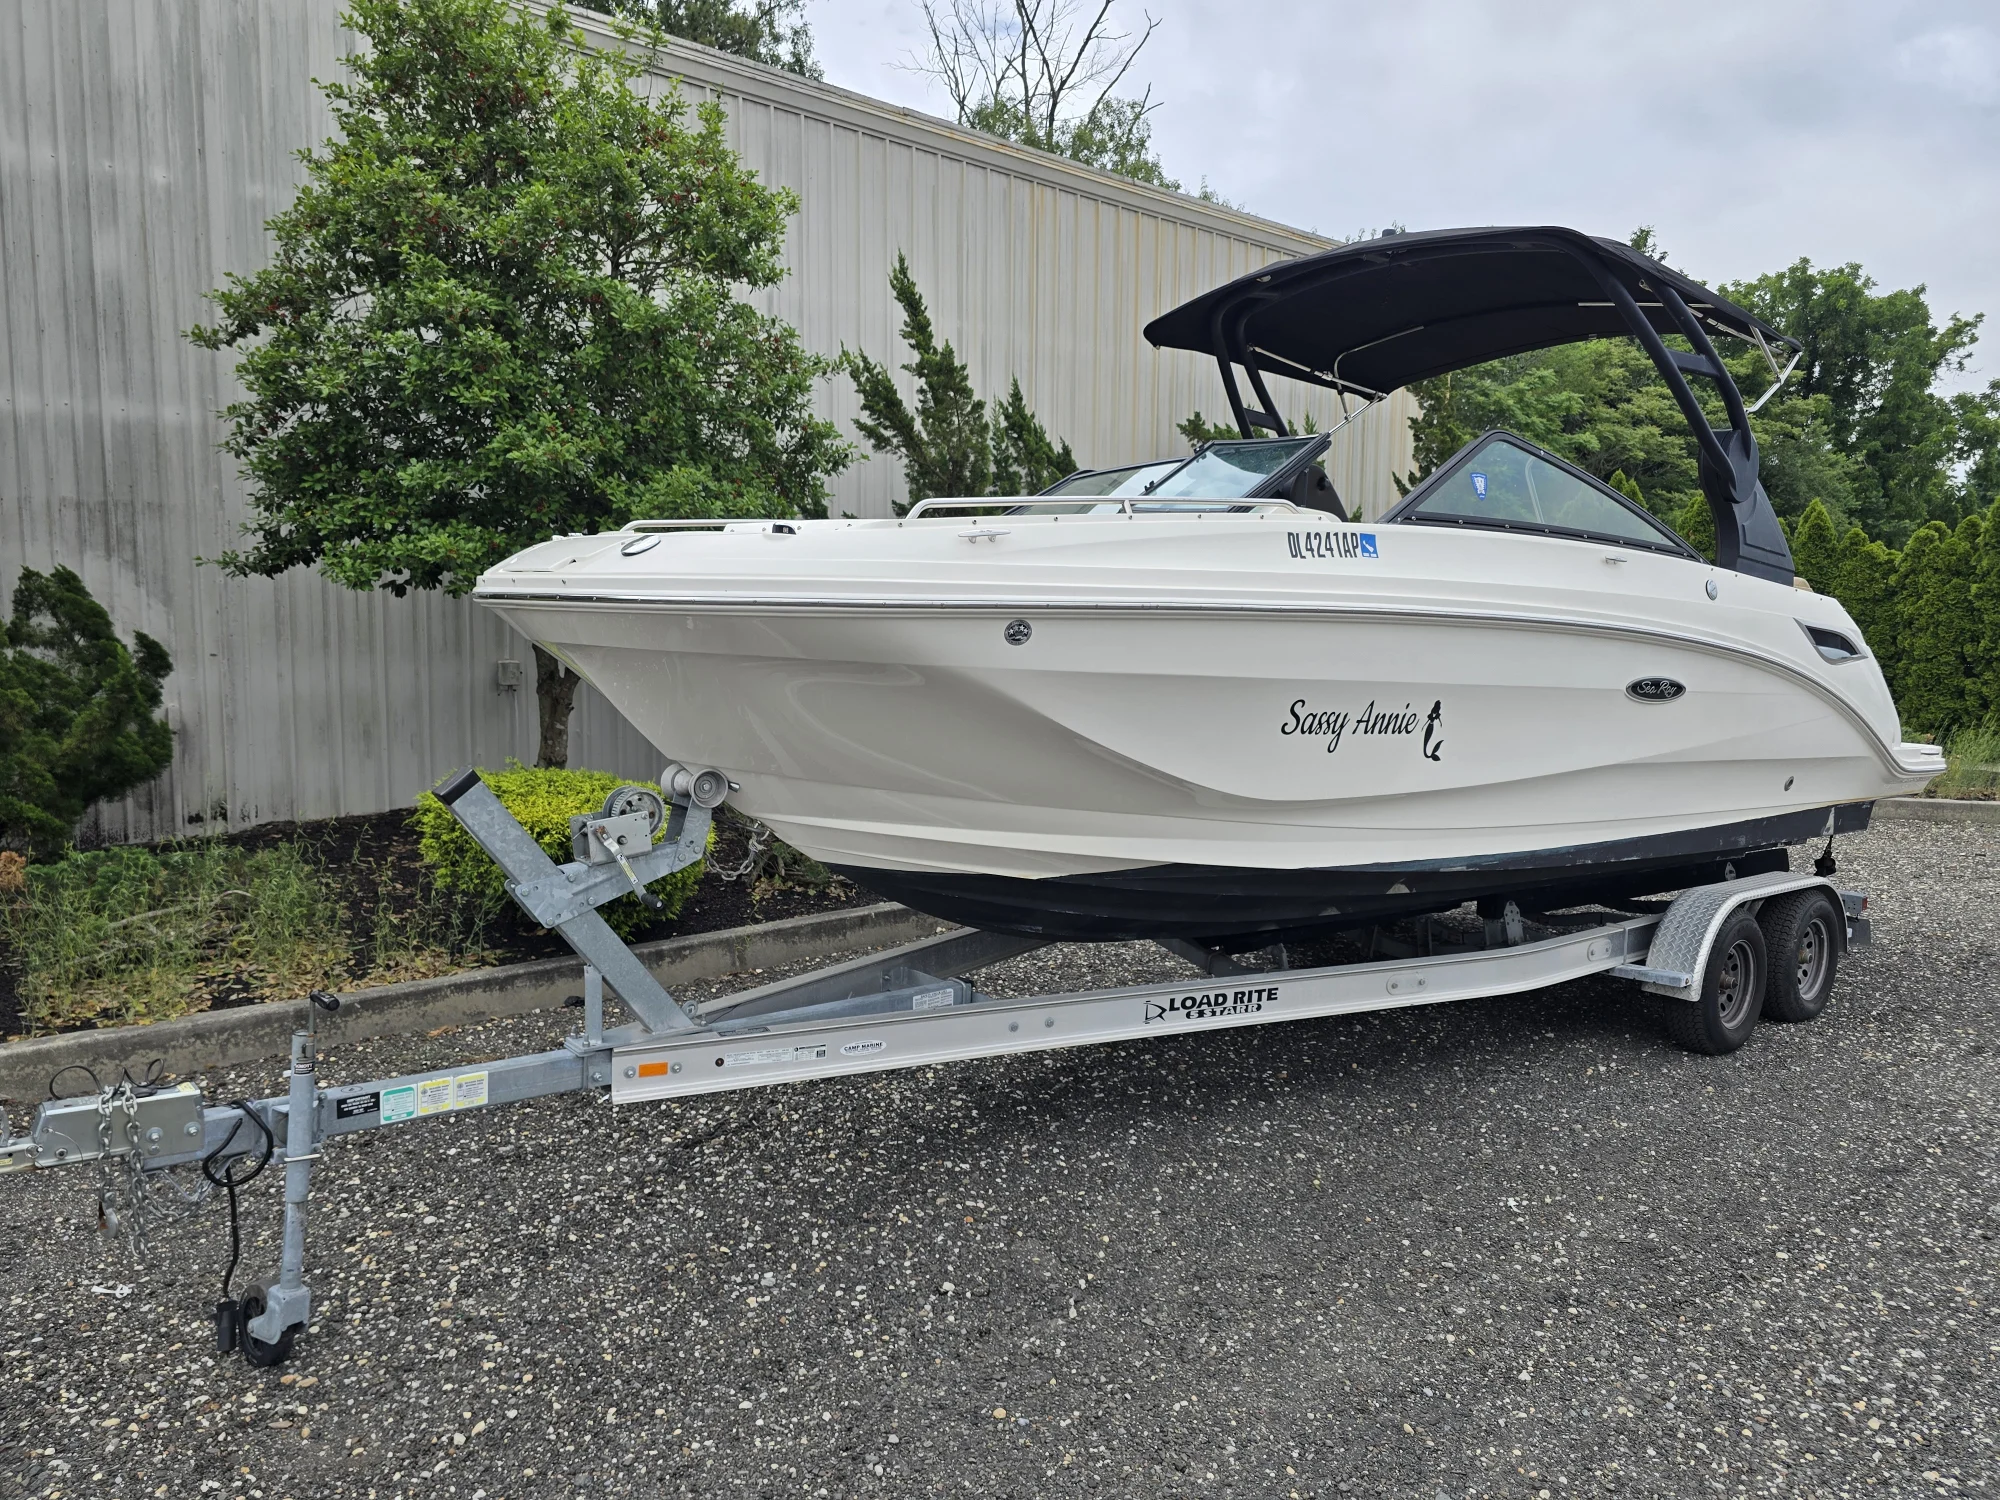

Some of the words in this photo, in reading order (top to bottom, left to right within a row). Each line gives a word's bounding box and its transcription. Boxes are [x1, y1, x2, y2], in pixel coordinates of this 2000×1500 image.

[1287, 532, 1359, 559] DL4241AP
[1637, 681, 1657, 694] Sea
[1657, 680, 1677, 698] Ray
[1281, 699, 1350, 753] Sassy
[1352, 700, 1420, 735] Annie
[1169, 993, 1228, 1012] LOAD
[1233, 987, 1279, 1005] RITE
